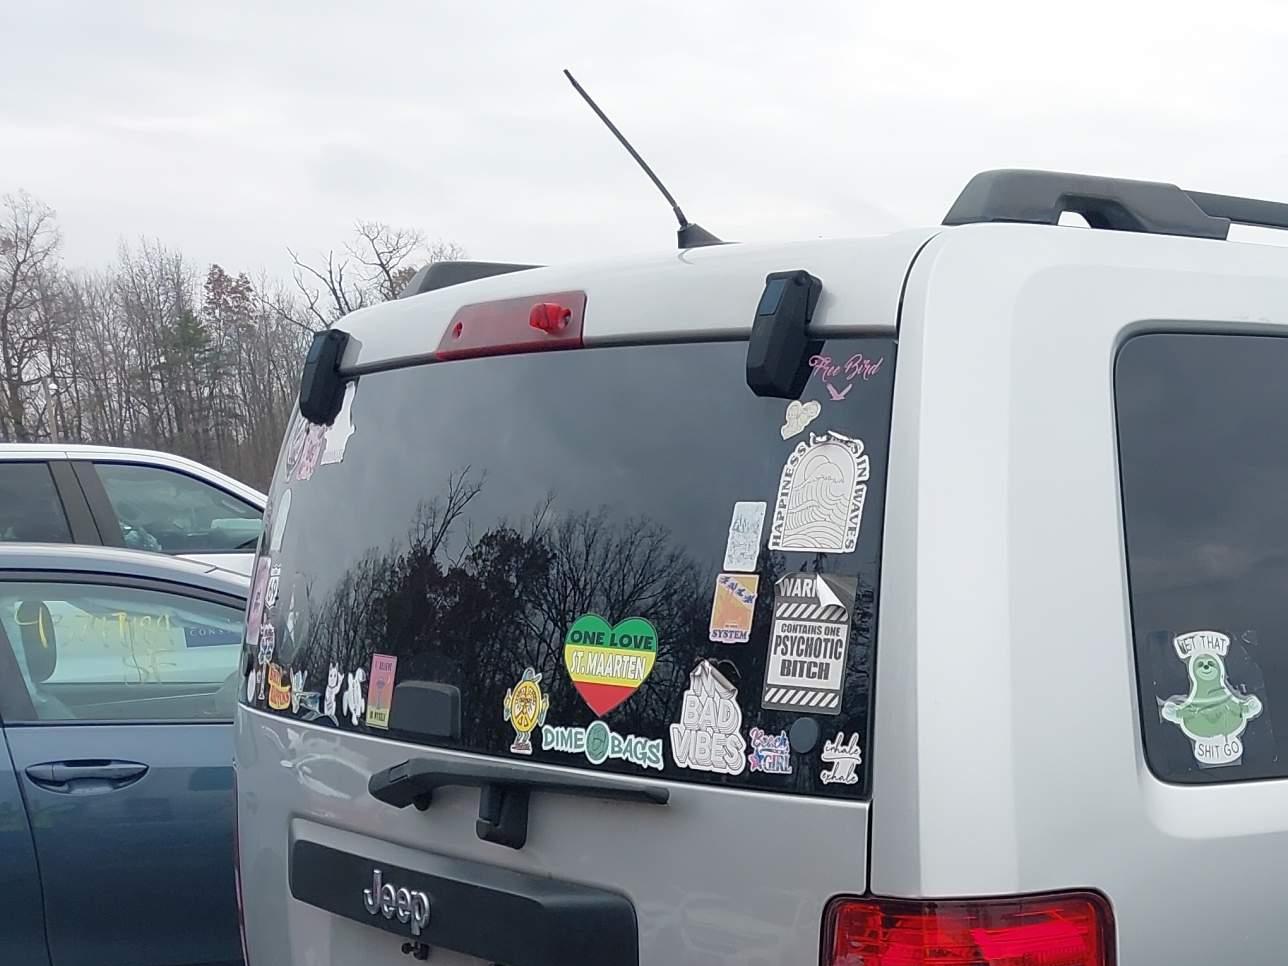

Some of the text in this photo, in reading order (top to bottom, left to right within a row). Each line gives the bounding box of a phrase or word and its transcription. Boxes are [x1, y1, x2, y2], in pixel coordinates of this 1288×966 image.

[808, 353, 884, 382] Free Bird
[771, 443, 807, 548] HAPPINESS
[844, 481, 866, 550] WAVES
[570, 630, 654, 650] ONE LOVE
[711, 629, 749, 641] SYSTEM
[780, 623, 841, 637] CONTAINS ONE
[773, 634, 844, 661] PSYCHOTIC
[1199, 635, 1226, 653] THAT
[779, 658, 831, 681] BITCH
[684, 694, 740, 733] BAD
[544, 726, 662, 766] DIME BAGS
[672, 727, 746, 771] VIBES
[824, 733, 860, 757] inhale
[1198, 740, 1240, 759] SHIT GO
[763, 754, 792, 774] GIRL
[821, 761, 859, 784] exhale
[363, 869, 431, 936] Jeep
